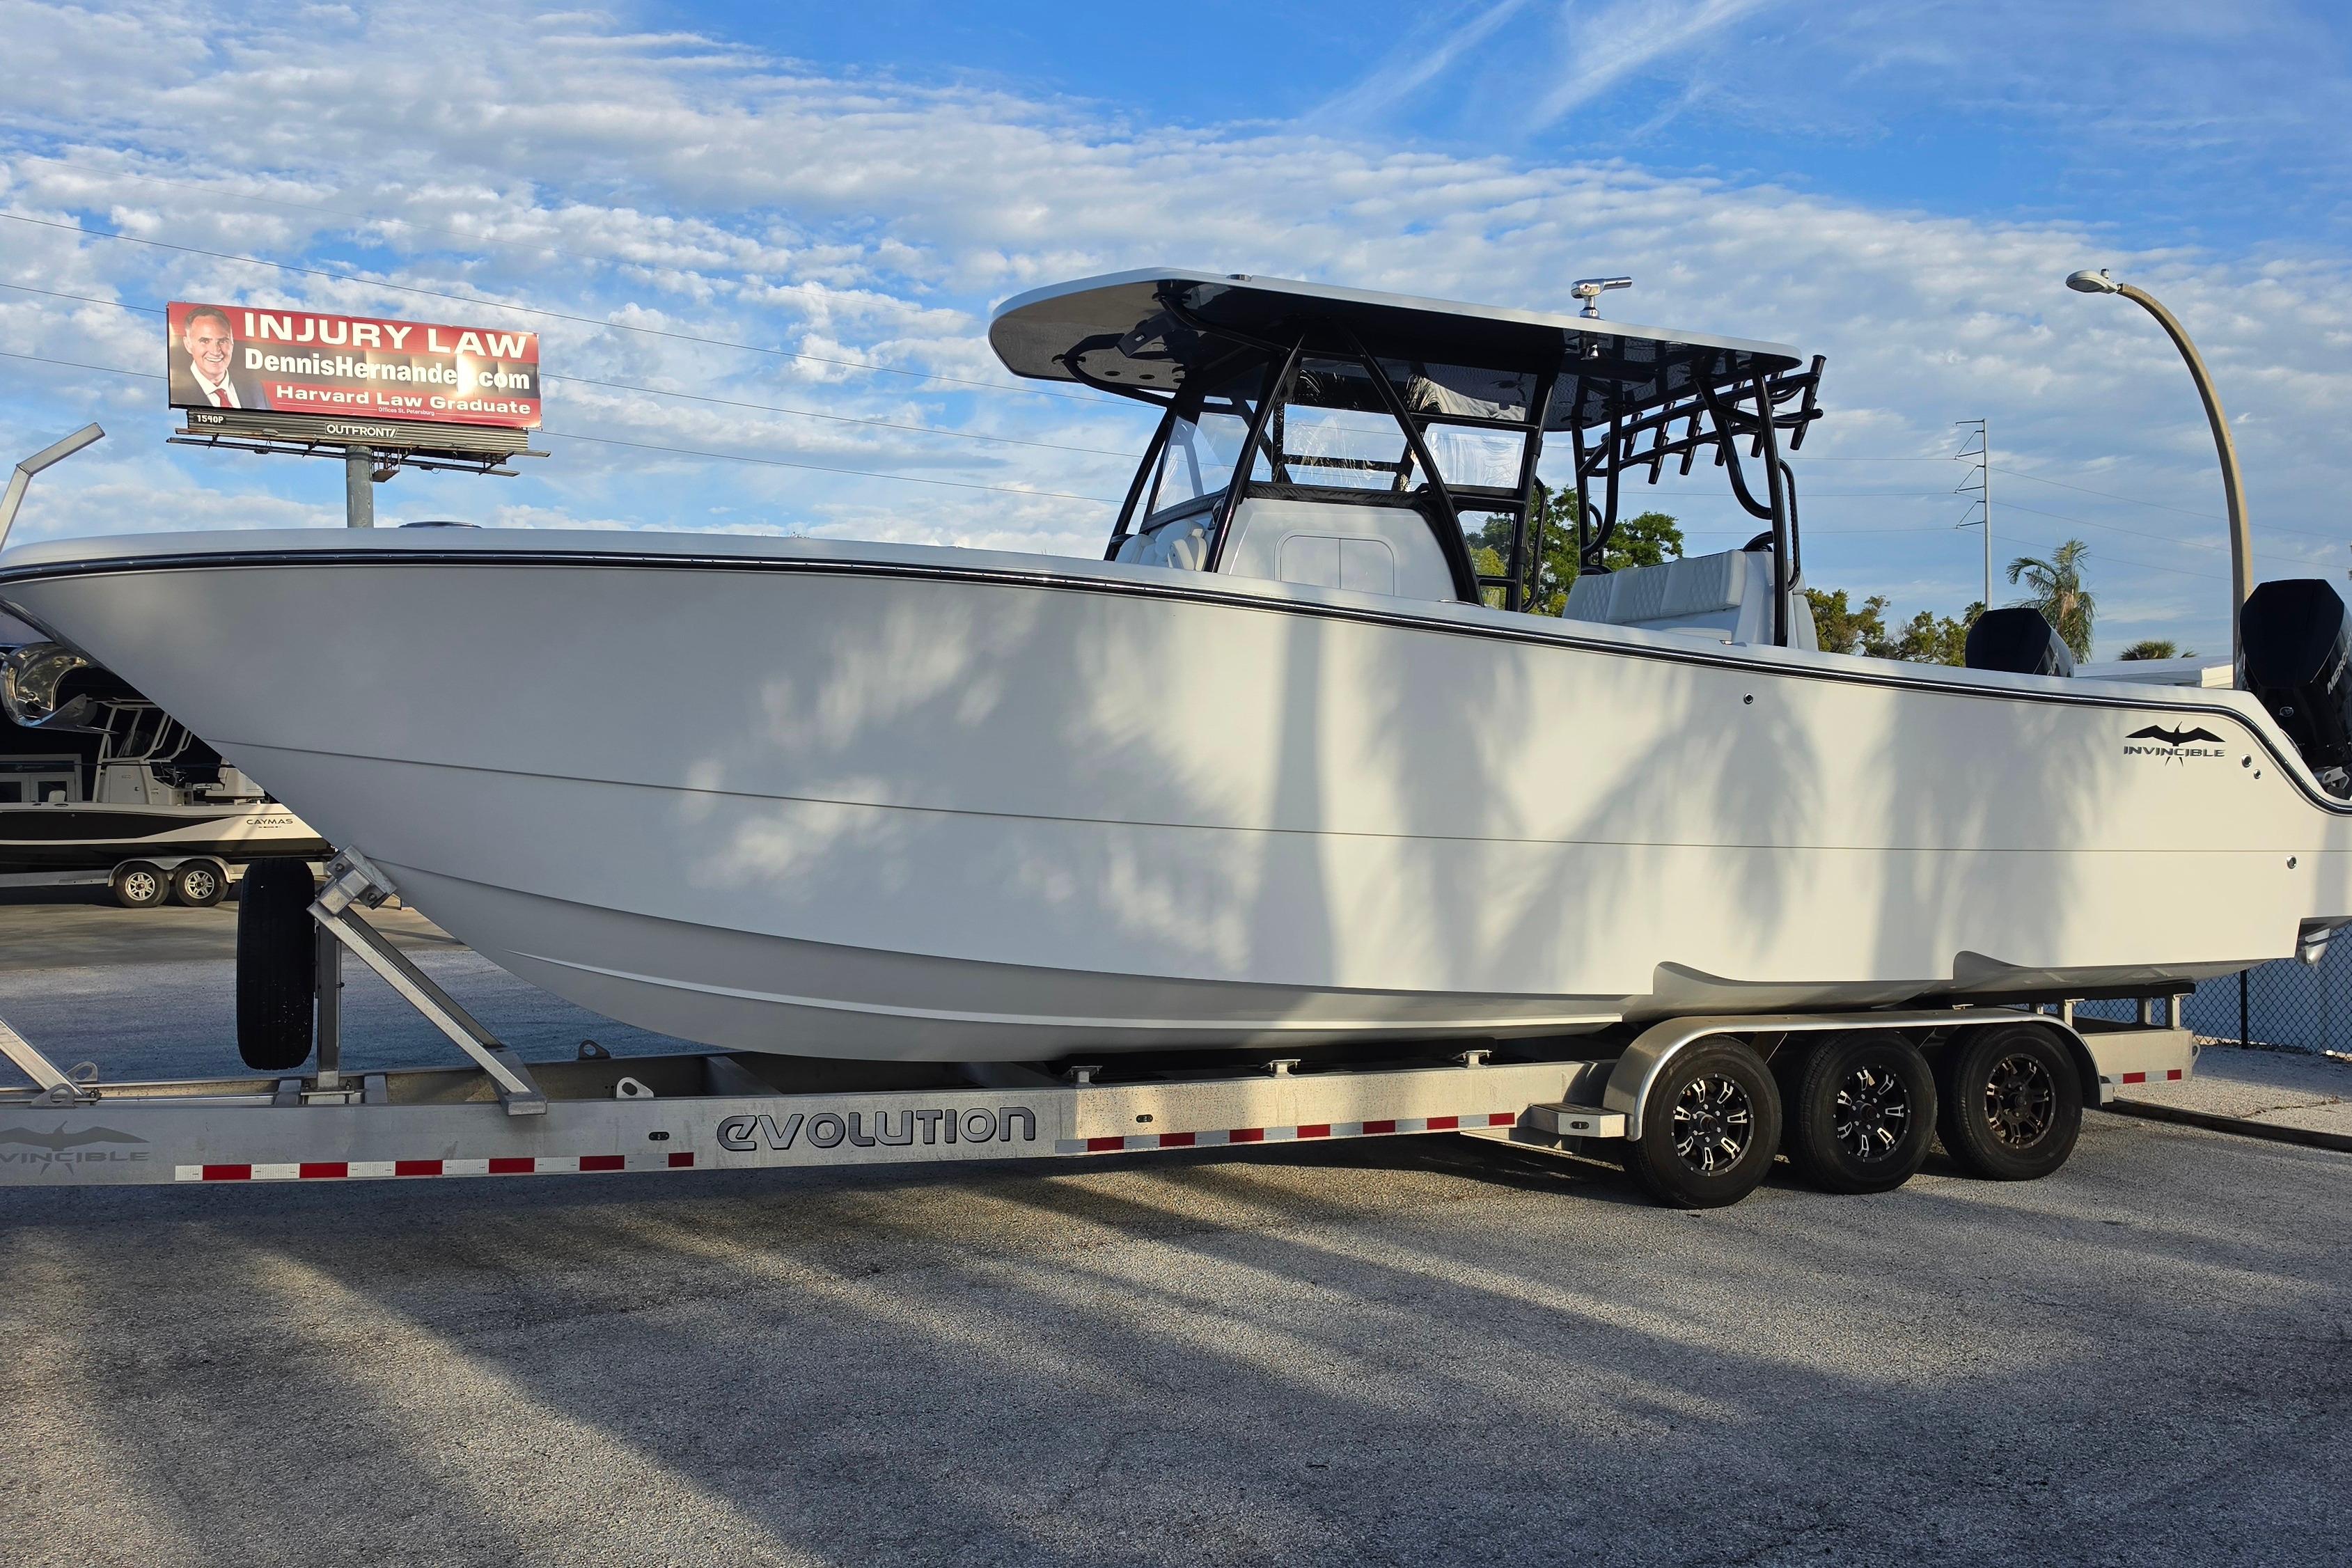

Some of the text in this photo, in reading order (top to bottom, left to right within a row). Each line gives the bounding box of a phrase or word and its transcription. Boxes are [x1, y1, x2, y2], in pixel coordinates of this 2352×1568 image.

[244, 311, 527, 359] INJURY LAW
[245, 347, 530, 390] DennisHernande.com
[276, 384, 531, 415] Harvard Law Graduate
[2124, 746, 2226, 758] INVINCIBLE
[0, 1151, 150, 1163] VINCIBLE
